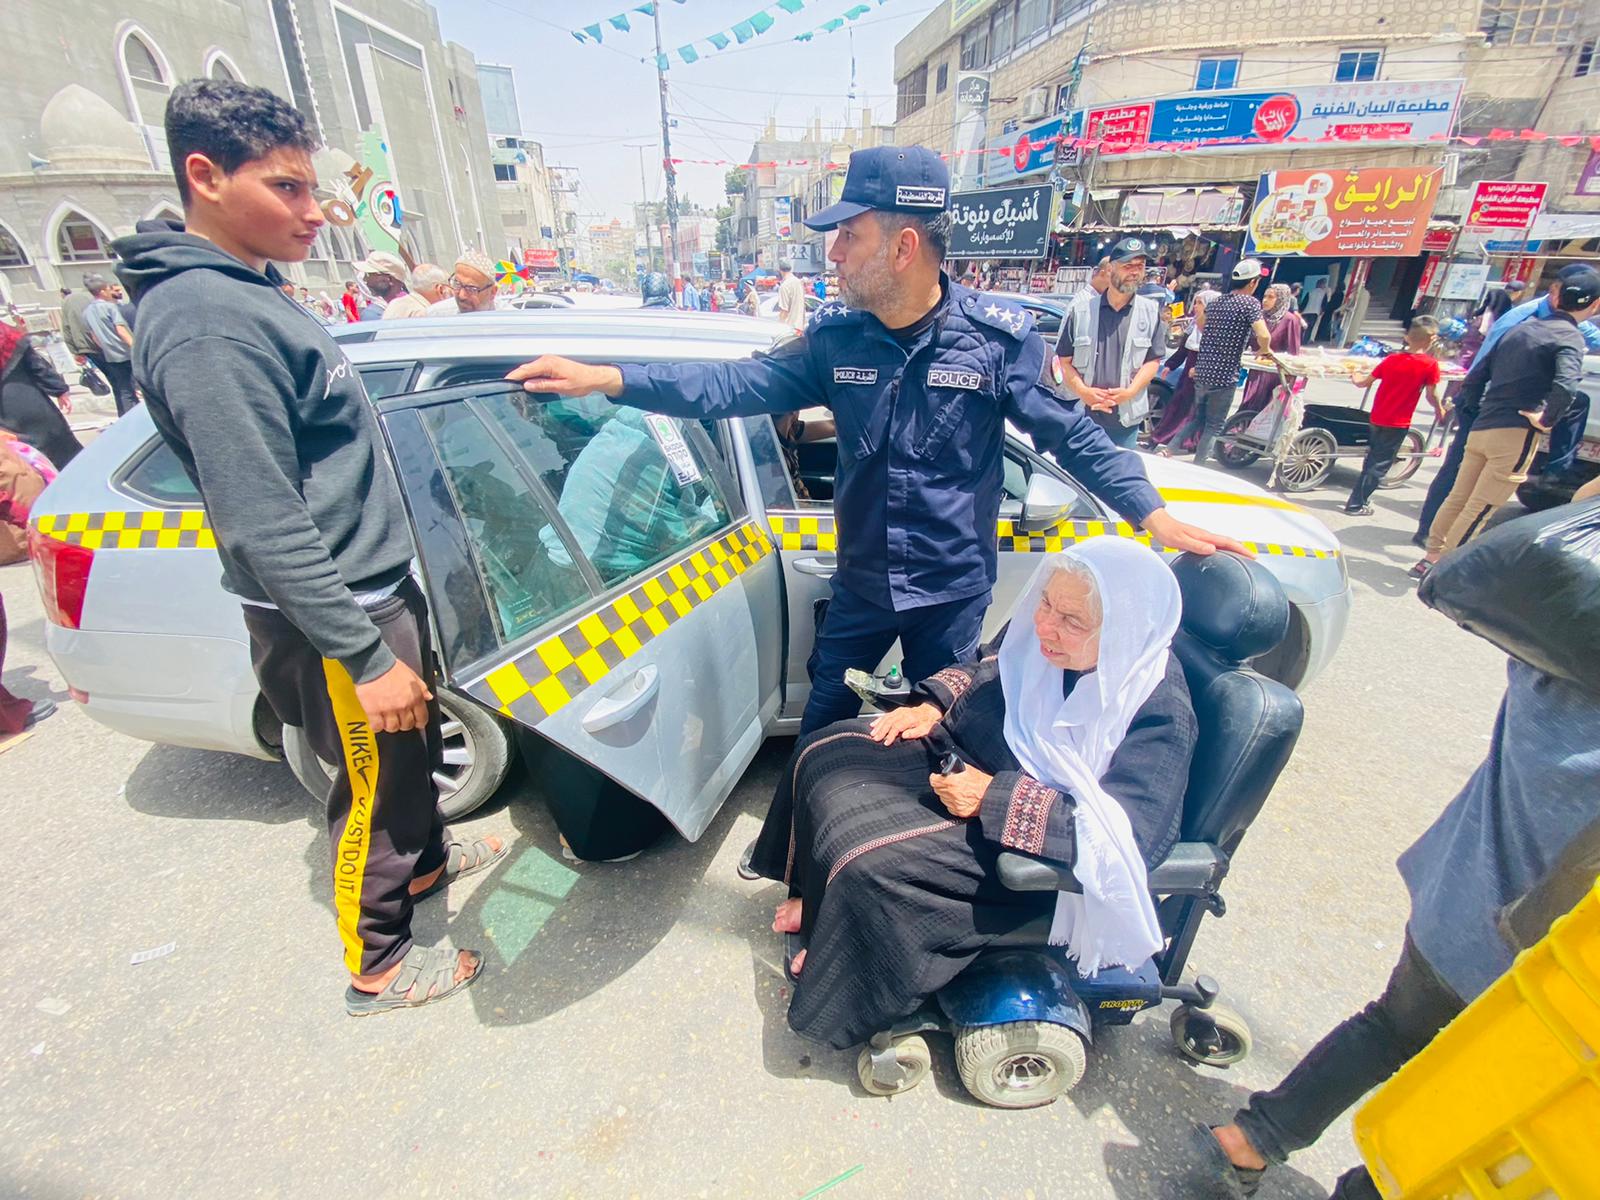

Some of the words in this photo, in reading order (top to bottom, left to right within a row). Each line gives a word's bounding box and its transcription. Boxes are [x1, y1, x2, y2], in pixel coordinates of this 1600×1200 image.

[1099, 107, 1137, 123] مطبعة
[1311, 101, 1355, 118] الفنية
[1356, 100, 1395, 118] البيان
[1396, 98, 1450, 116] مطبعة
[1334, 174, 1433, 212] الرايق
[951, 203, 990, 232] بنوتة
[992, 189, 1040, 227] أشيك
[929, 372, 977, 386] POLICE
[347, 721, 373, 768] NIKE
[339, 850, 360, 875] DO
